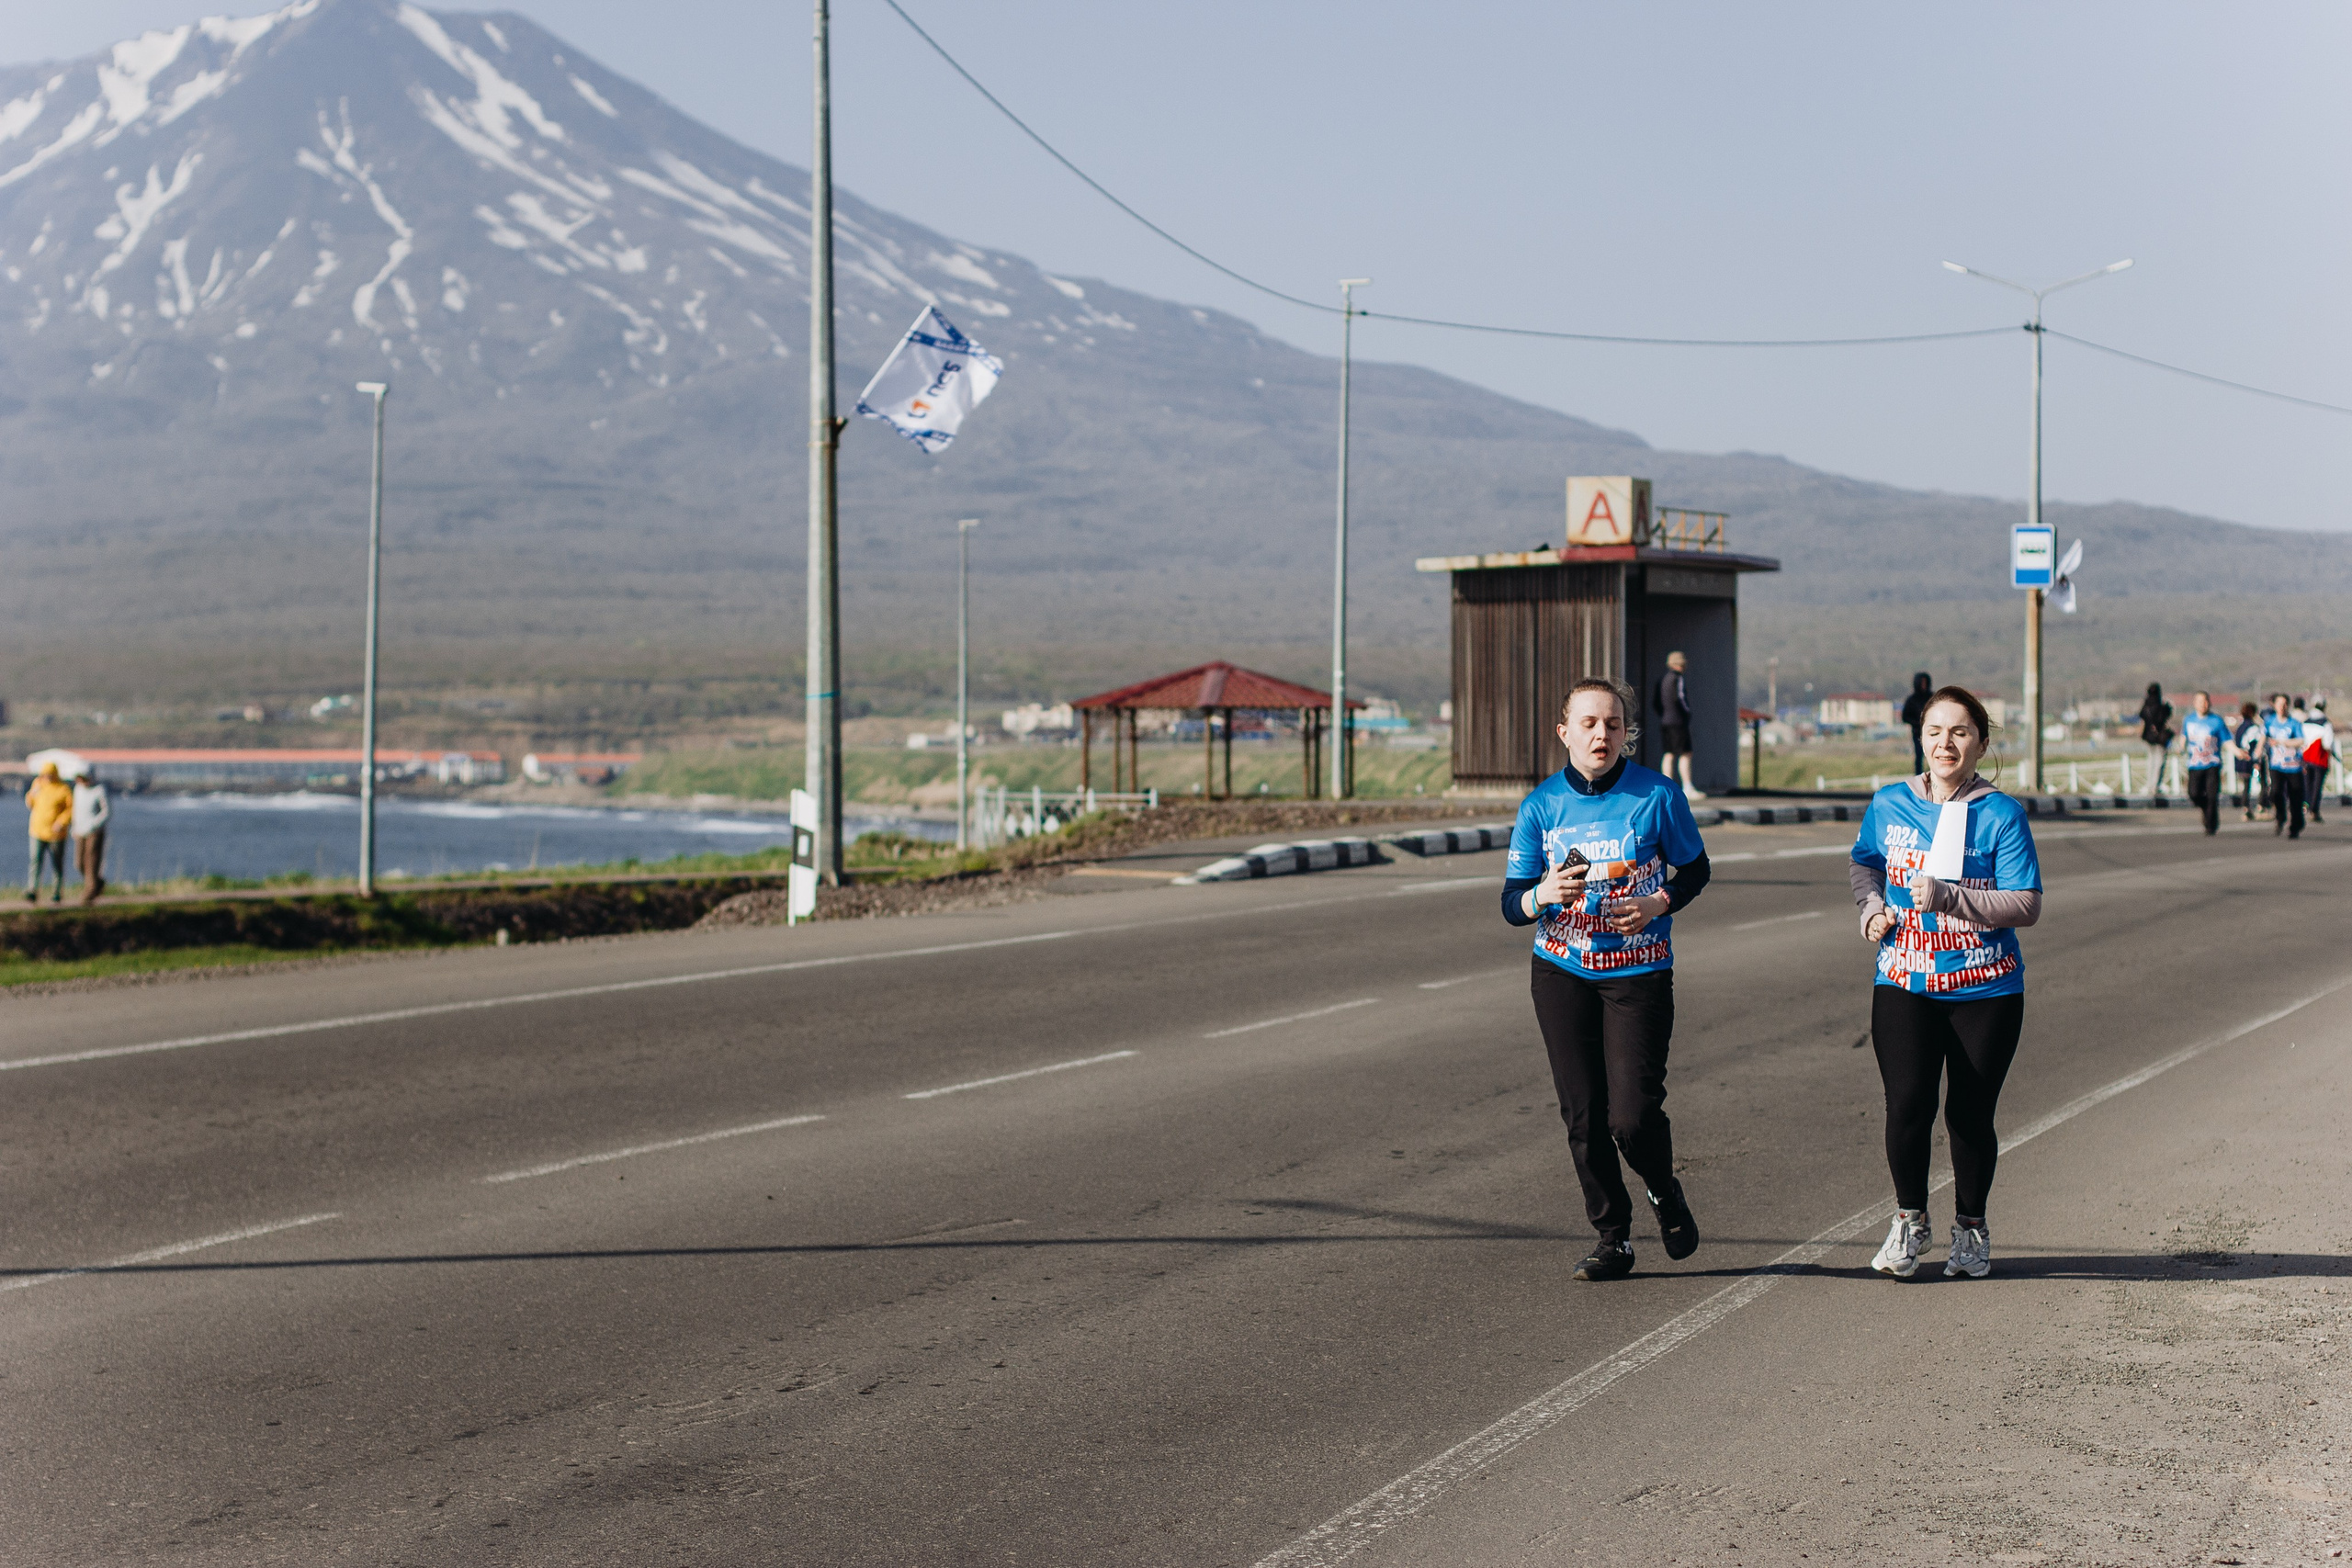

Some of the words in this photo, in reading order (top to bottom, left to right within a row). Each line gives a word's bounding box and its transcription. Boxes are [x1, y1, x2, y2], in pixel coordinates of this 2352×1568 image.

[1580, 489, 1620, 536] А
[1883, 824, 1919, 849] 2024
[1886, 845, 1927, 871] #МЕЧТ
[1894, 927, 1984, 953] #ГОРДОСТЬ
[1581, 938, 1670, 971] #ЕДИНСТВО
[1964, 942, 2003, 969] 2024
[1925, 952, 2018, 993] #ЕДИНСТВО
